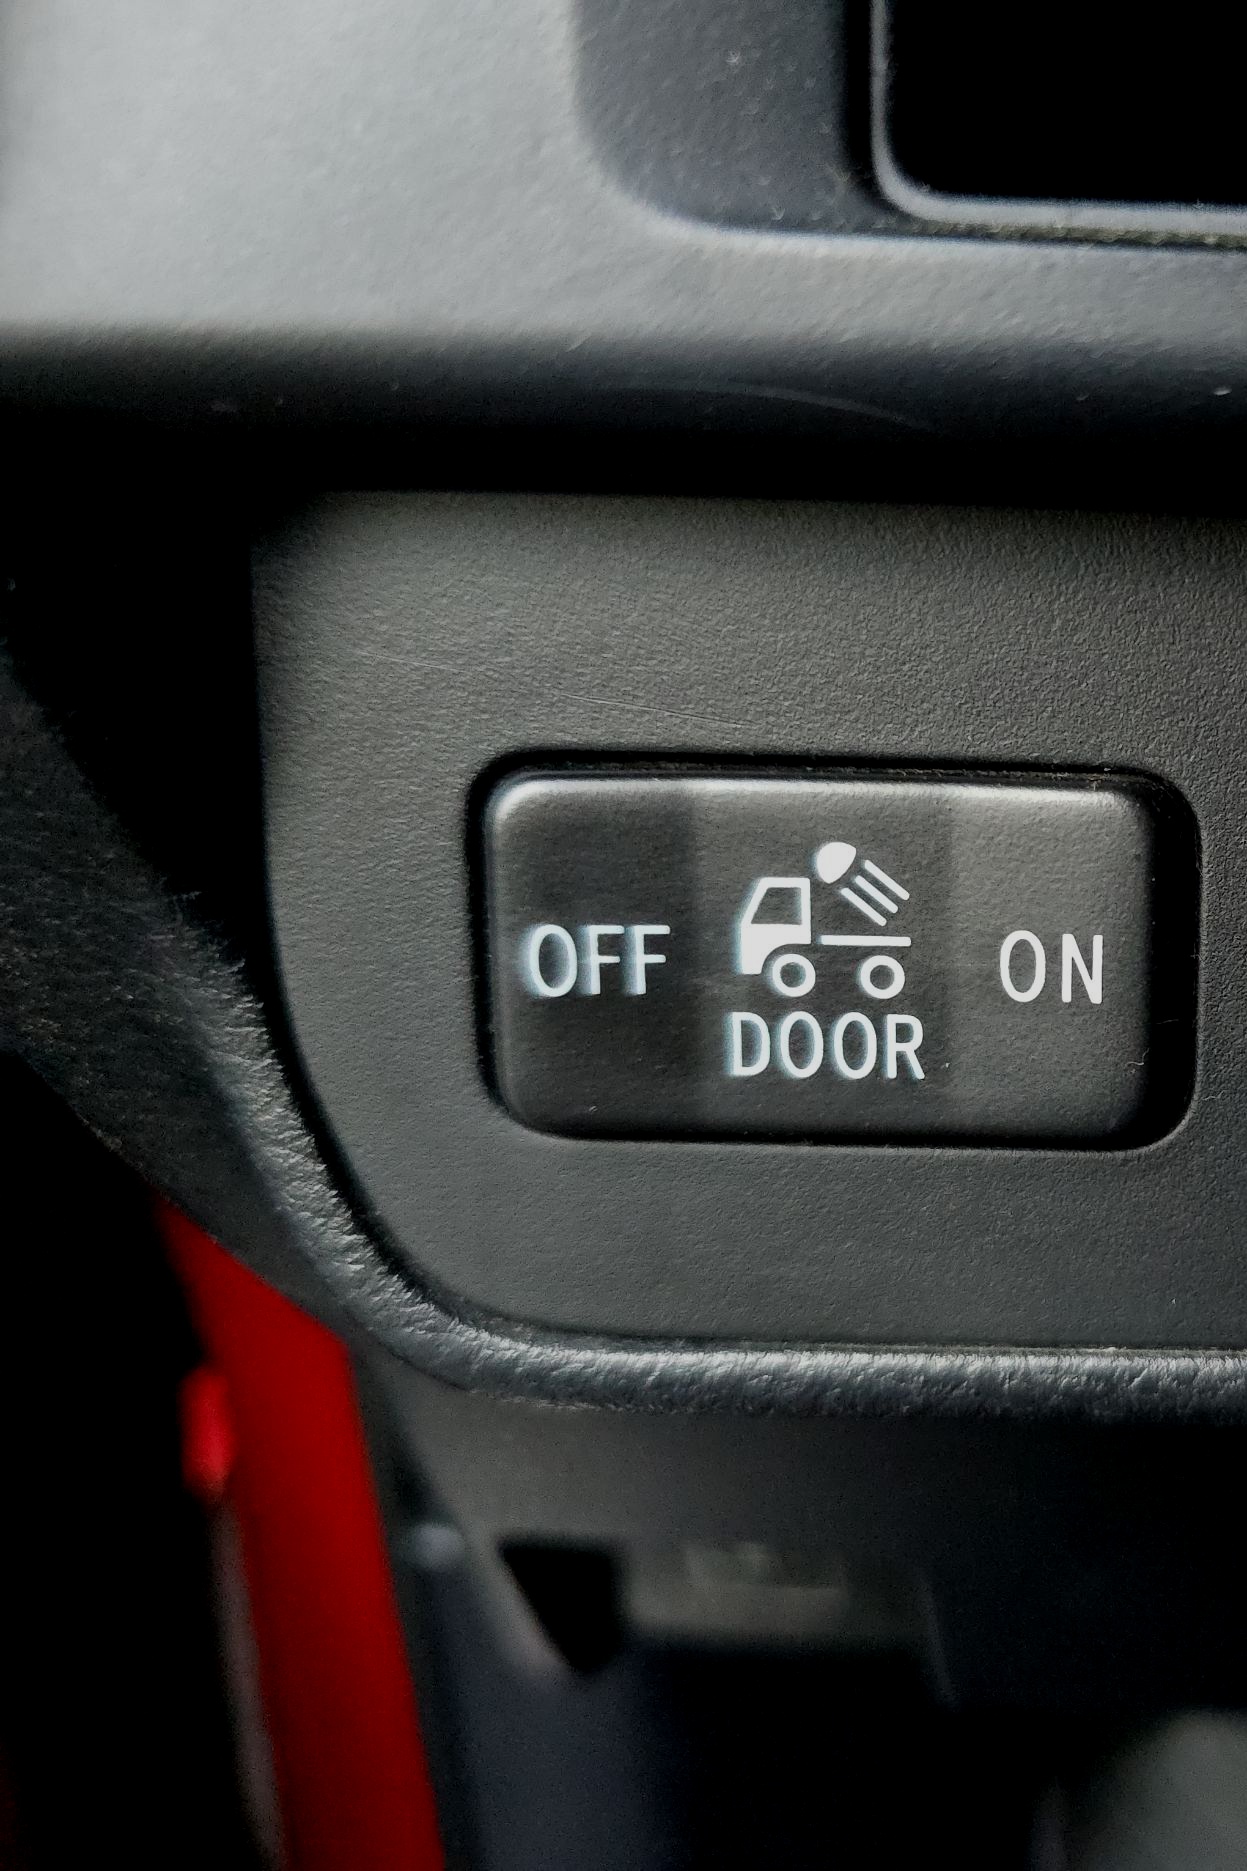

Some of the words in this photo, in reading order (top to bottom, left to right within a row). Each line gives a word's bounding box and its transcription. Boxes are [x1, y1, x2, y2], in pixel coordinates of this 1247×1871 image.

[525, 923, 671, 998] OFF
[998, 930, 1104, 1005] ON
[728, 1011, 926, 1080] DOOR
